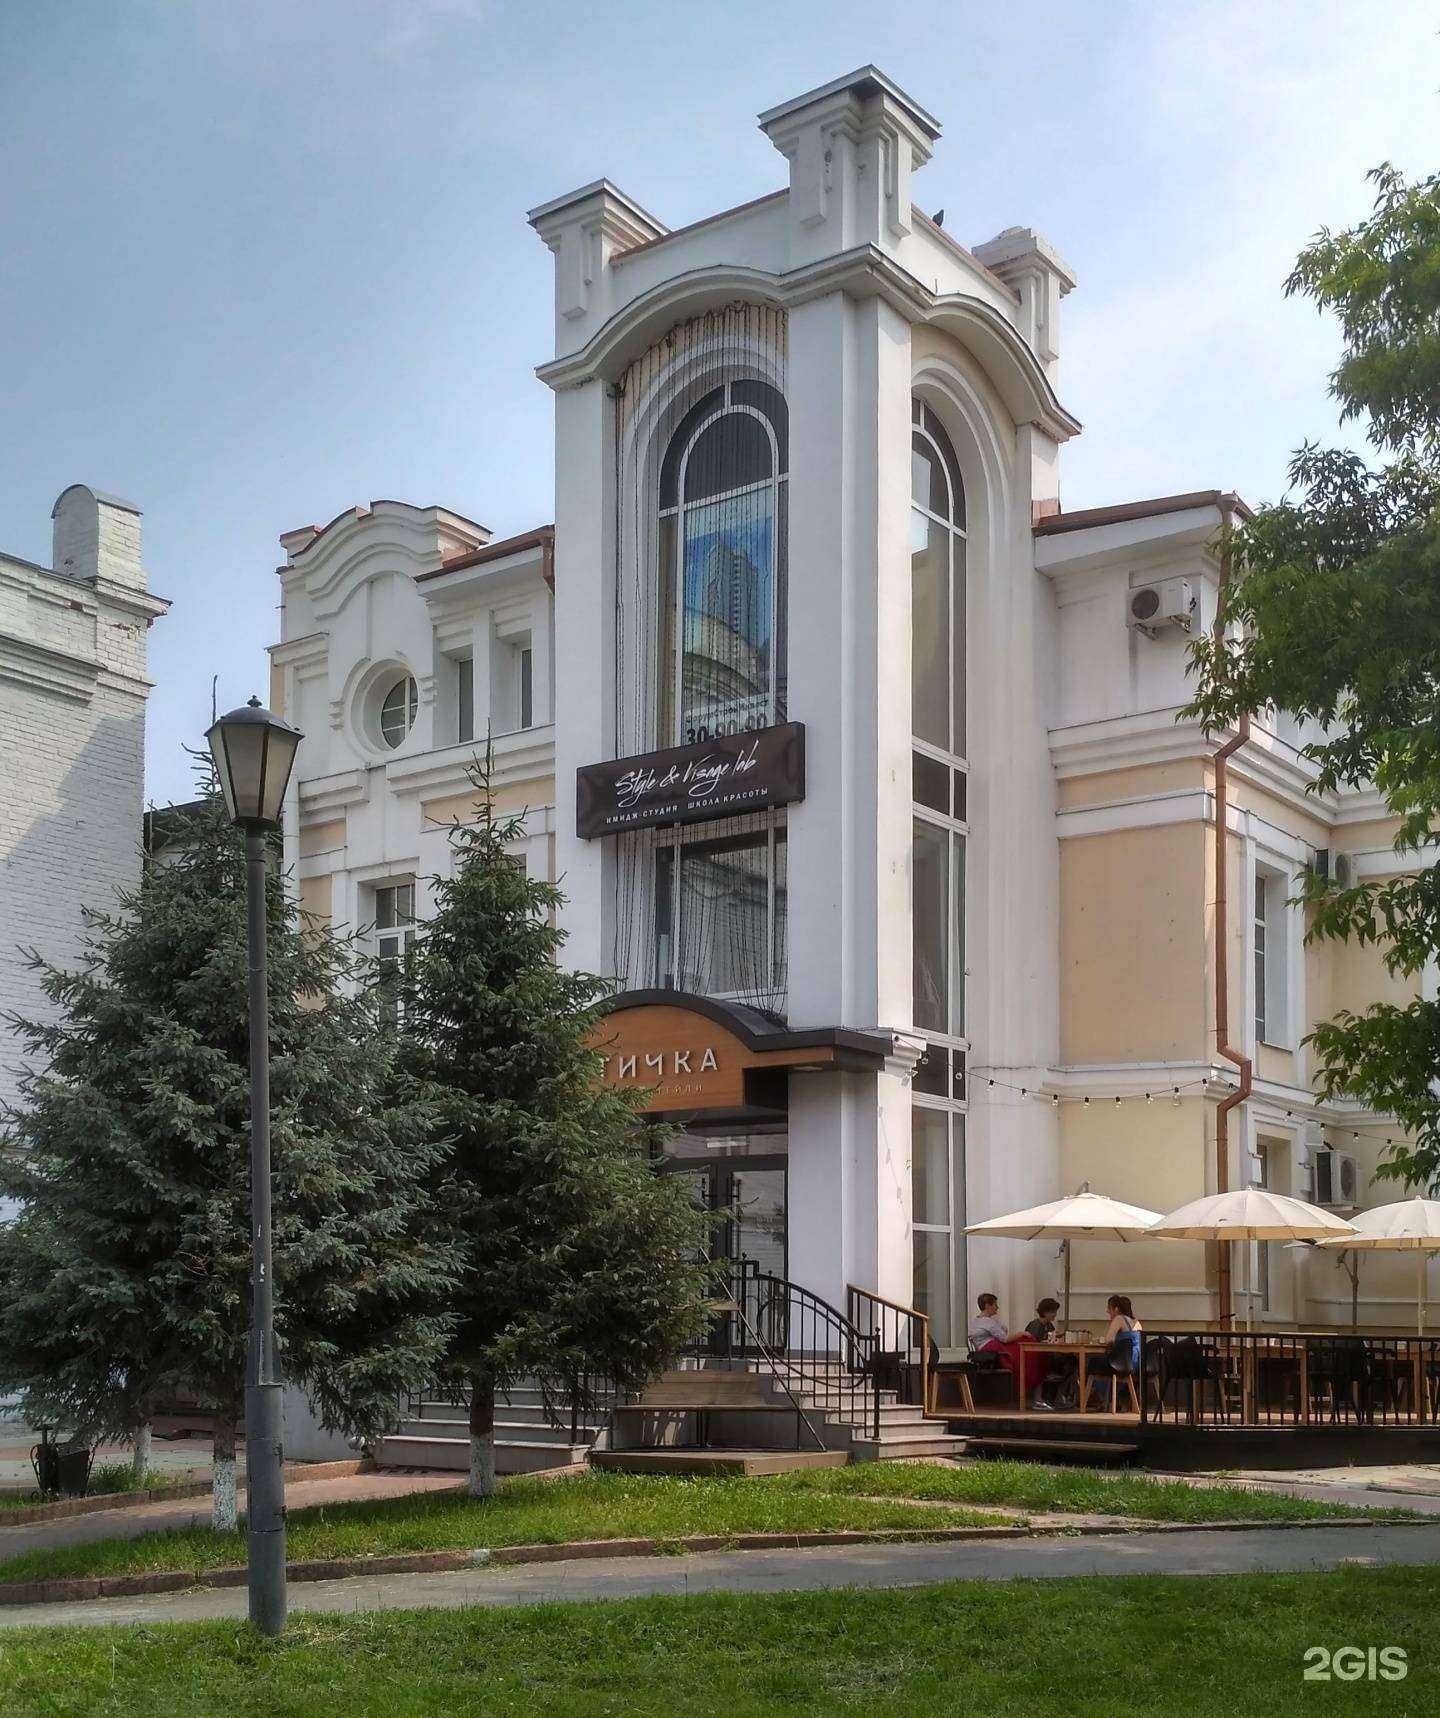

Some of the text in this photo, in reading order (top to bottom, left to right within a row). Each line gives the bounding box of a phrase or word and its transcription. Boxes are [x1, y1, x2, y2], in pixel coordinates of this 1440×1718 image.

[615, 740, 760, 808] Style & Visage lab
[687, 797, 720, 809] ШКОЛА
[723, 788, 769, 803] КРАСОТЫ
